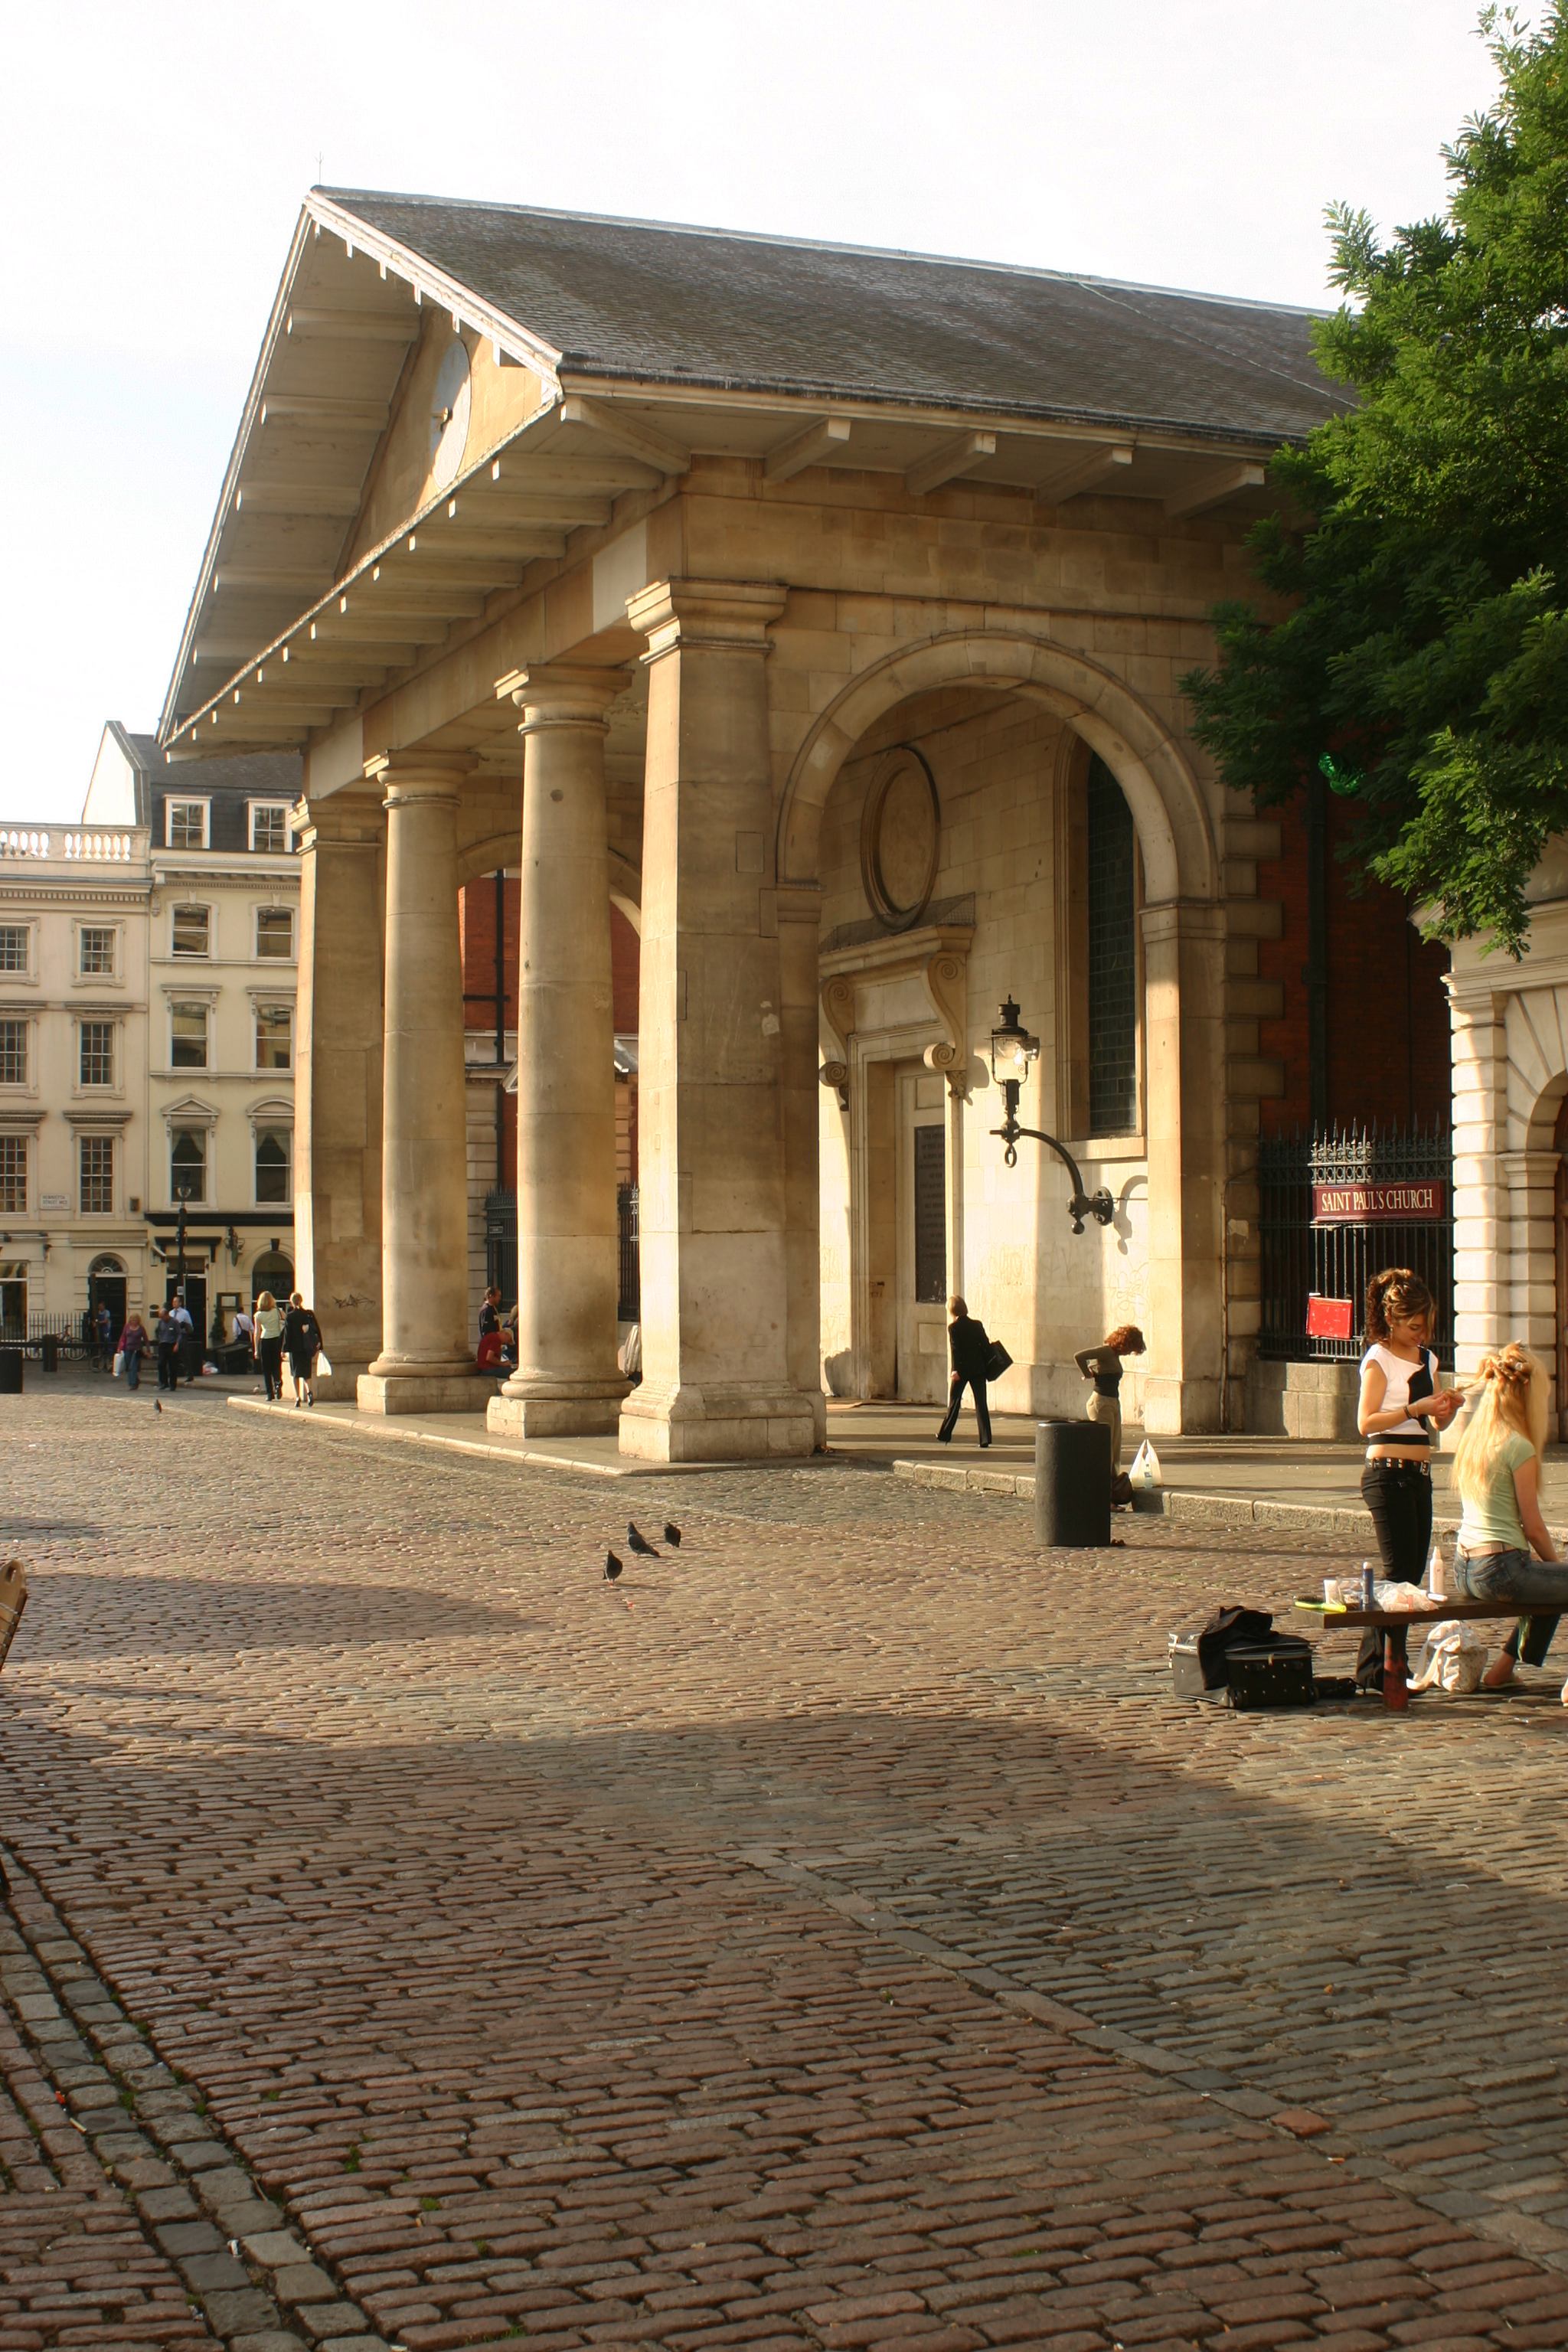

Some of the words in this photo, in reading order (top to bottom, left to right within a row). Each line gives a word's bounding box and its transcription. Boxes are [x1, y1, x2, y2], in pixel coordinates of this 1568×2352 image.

[1321, 1191, 1351, 1211] SAINT
[1353, 1190, 1384, 1210] PAUL'S
[1386, 1189, 1433, 1209] CHURCH
